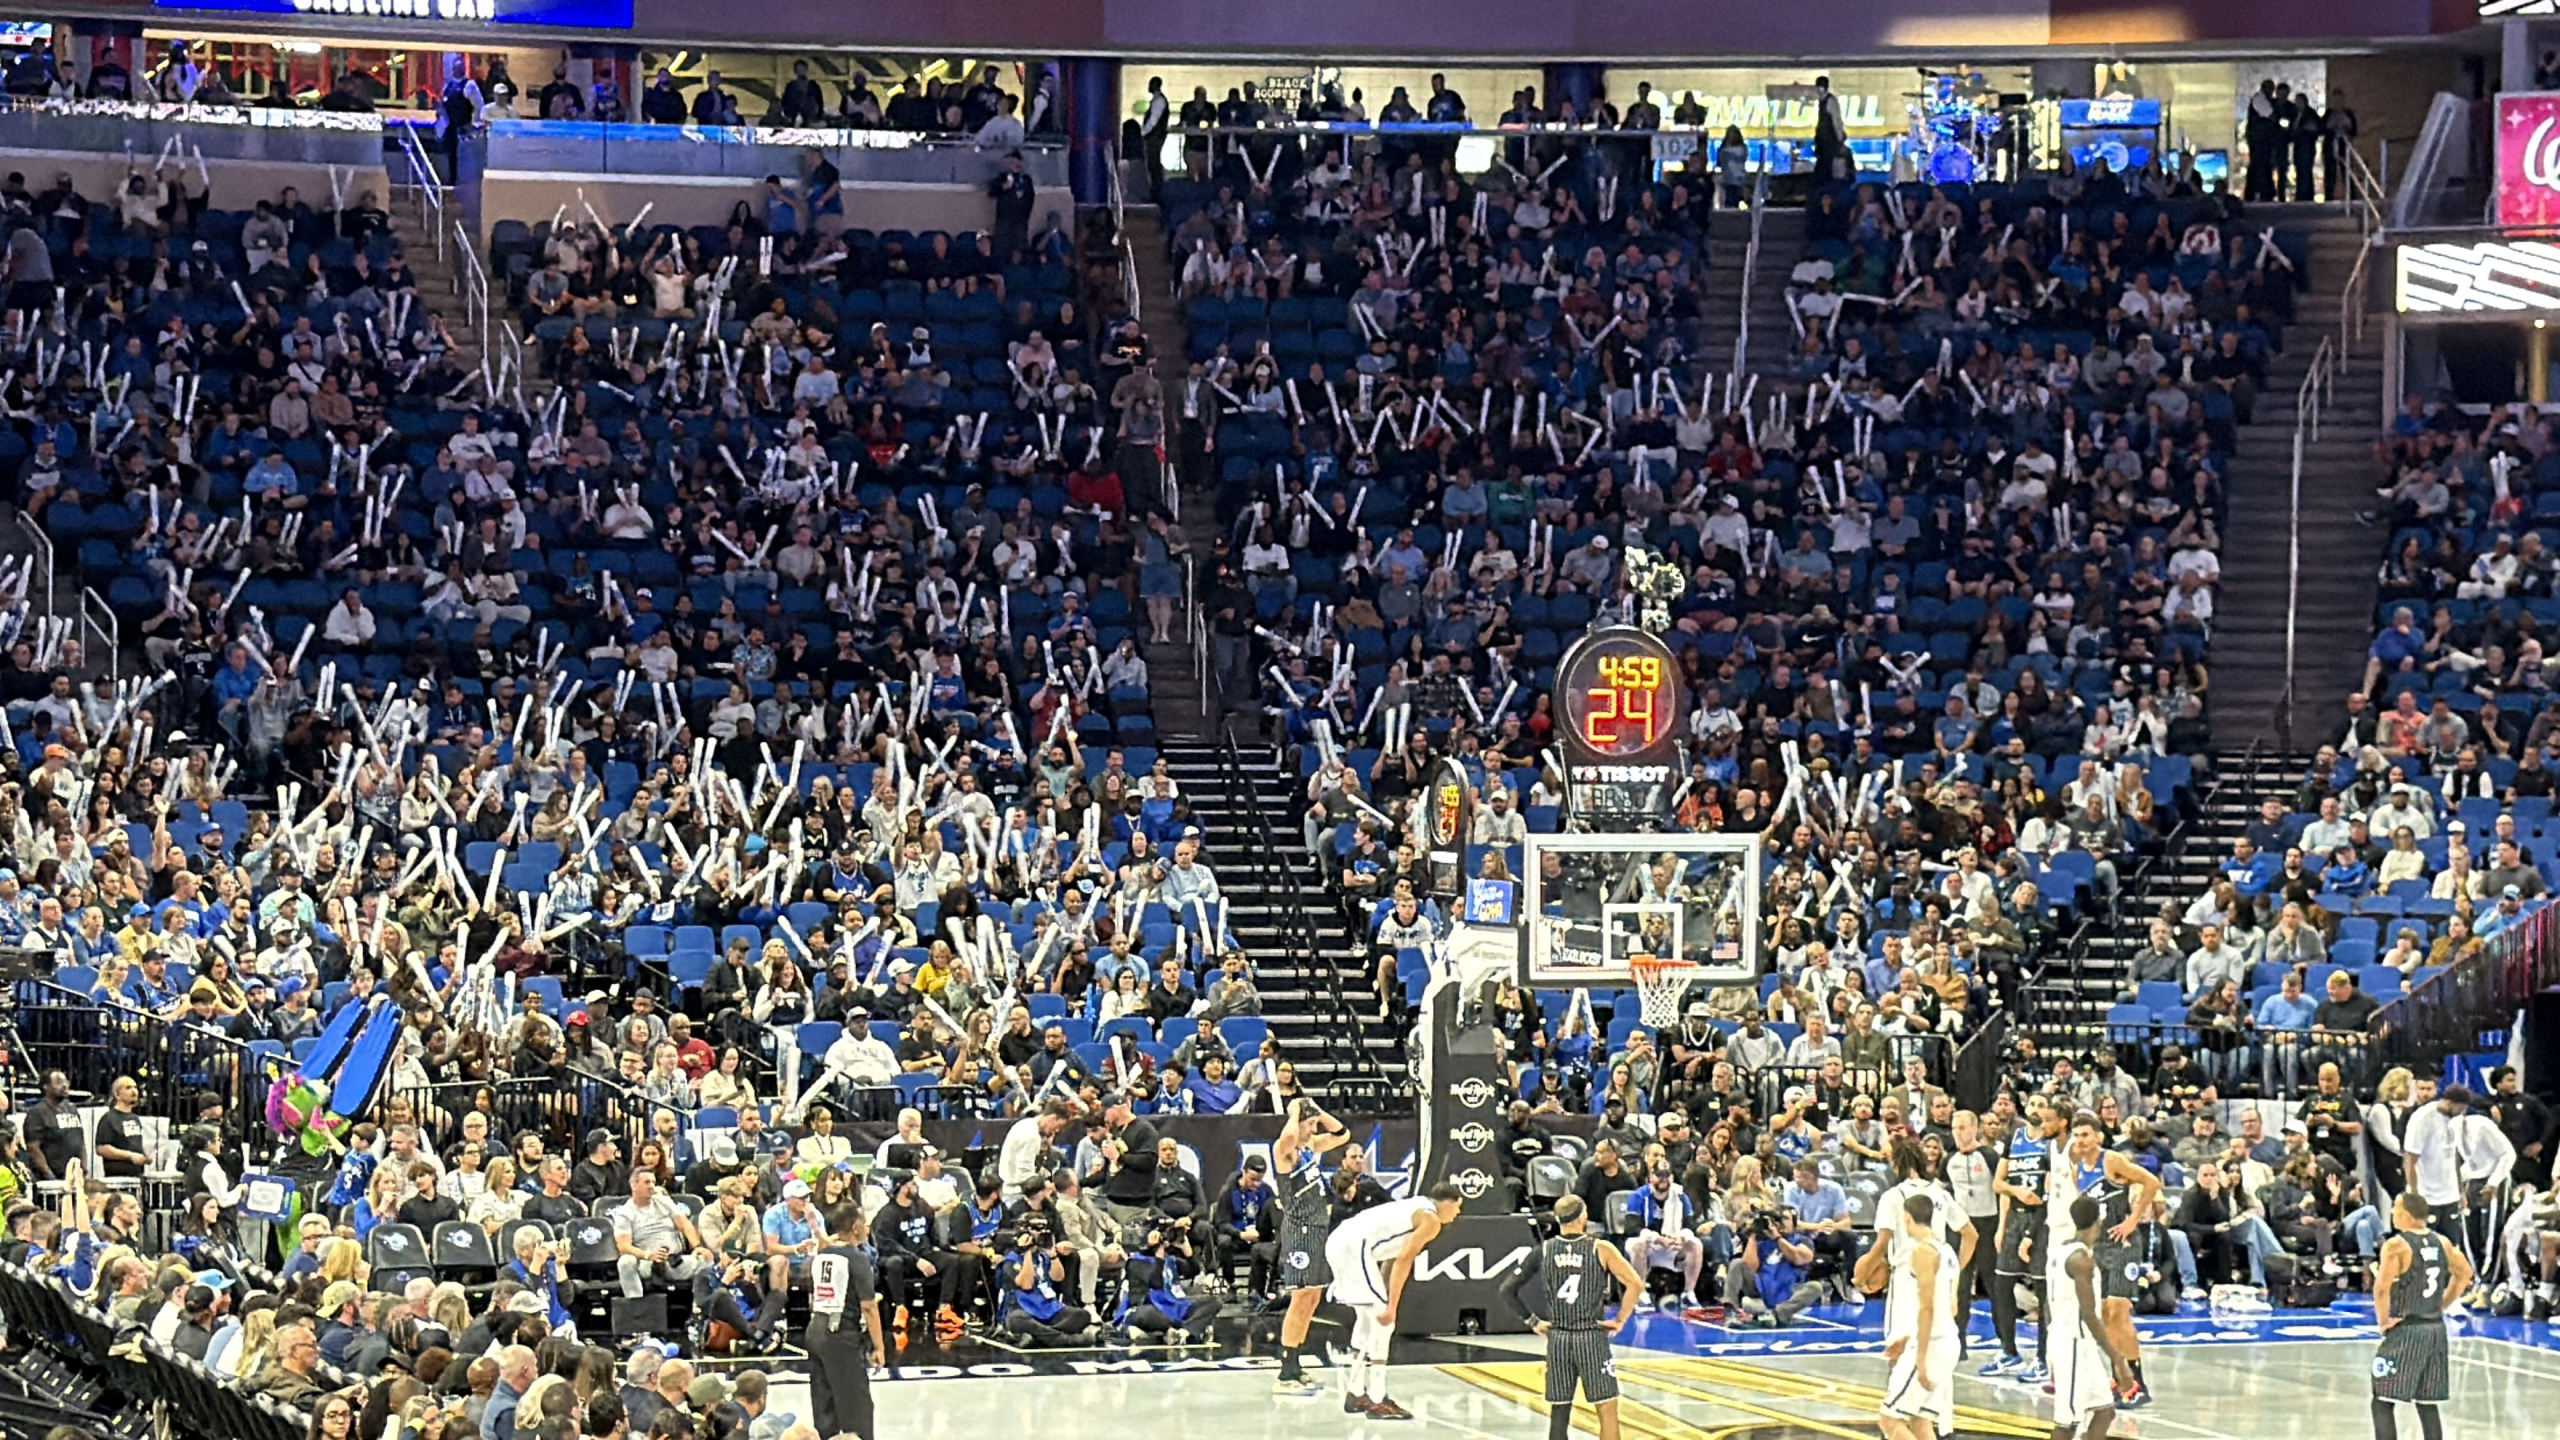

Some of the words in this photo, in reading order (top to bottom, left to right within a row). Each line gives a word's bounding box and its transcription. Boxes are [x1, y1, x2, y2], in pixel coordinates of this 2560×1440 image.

[1657, 137, 1696, 157] 102
[1599, 656, 1661, 688] 4:59
[1588, 688, 1653, 742] 24
[1598, 766, 1670, 782] TISSOT
[1557, 1274, 1582, 1304] 4
[2422, 1266, 2441, 1299] 3
[1068, 1355, 1324, 1374] MAGI
